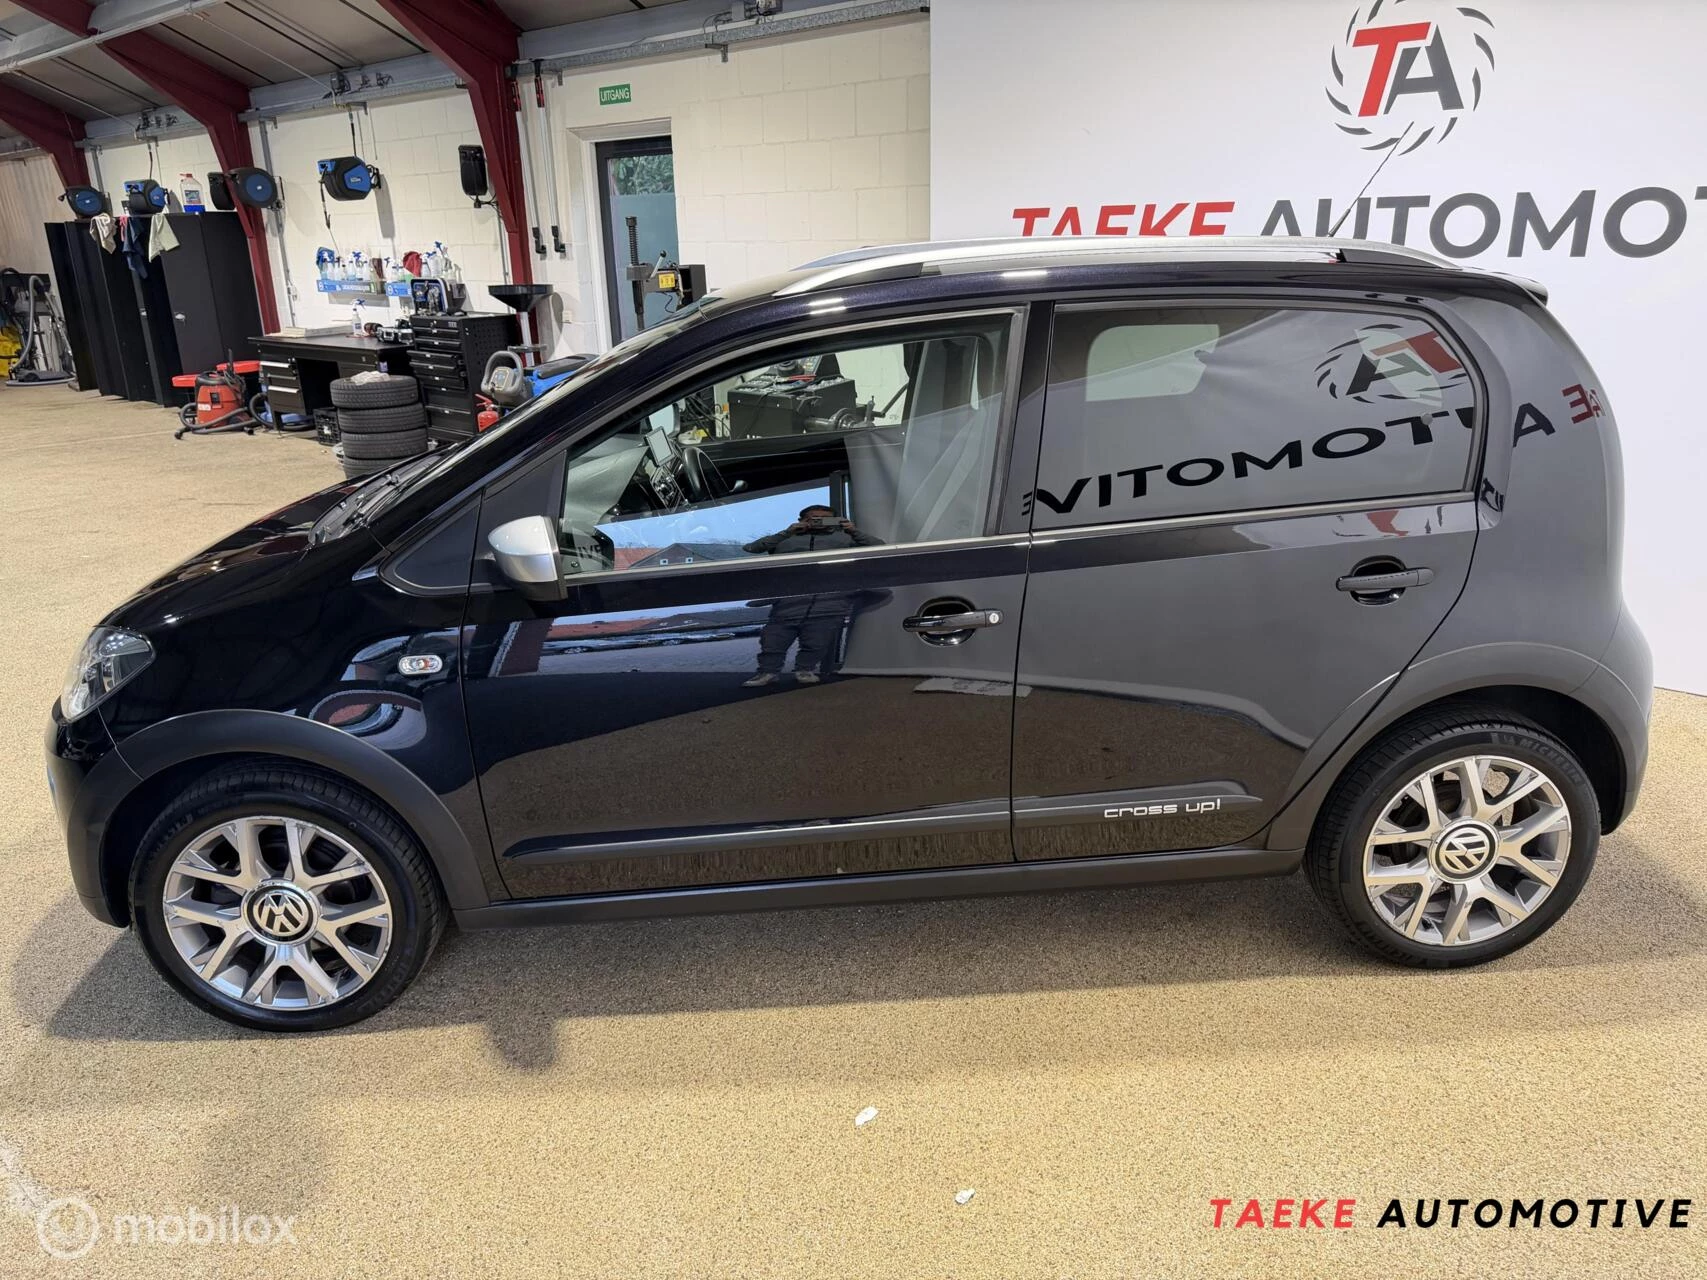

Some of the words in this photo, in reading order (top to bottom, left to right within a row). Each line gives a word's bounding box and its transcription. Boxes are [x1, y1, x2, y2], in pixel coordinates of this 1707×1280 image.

[1352, 21, 1464, 117] TA
[600, 88, 630, 102] UITGANG
[1259, 186, 1707, 258] AUTOMO
[1104, 804, 1178, 818] cross
[1185, 798, 1221, 813] up!
